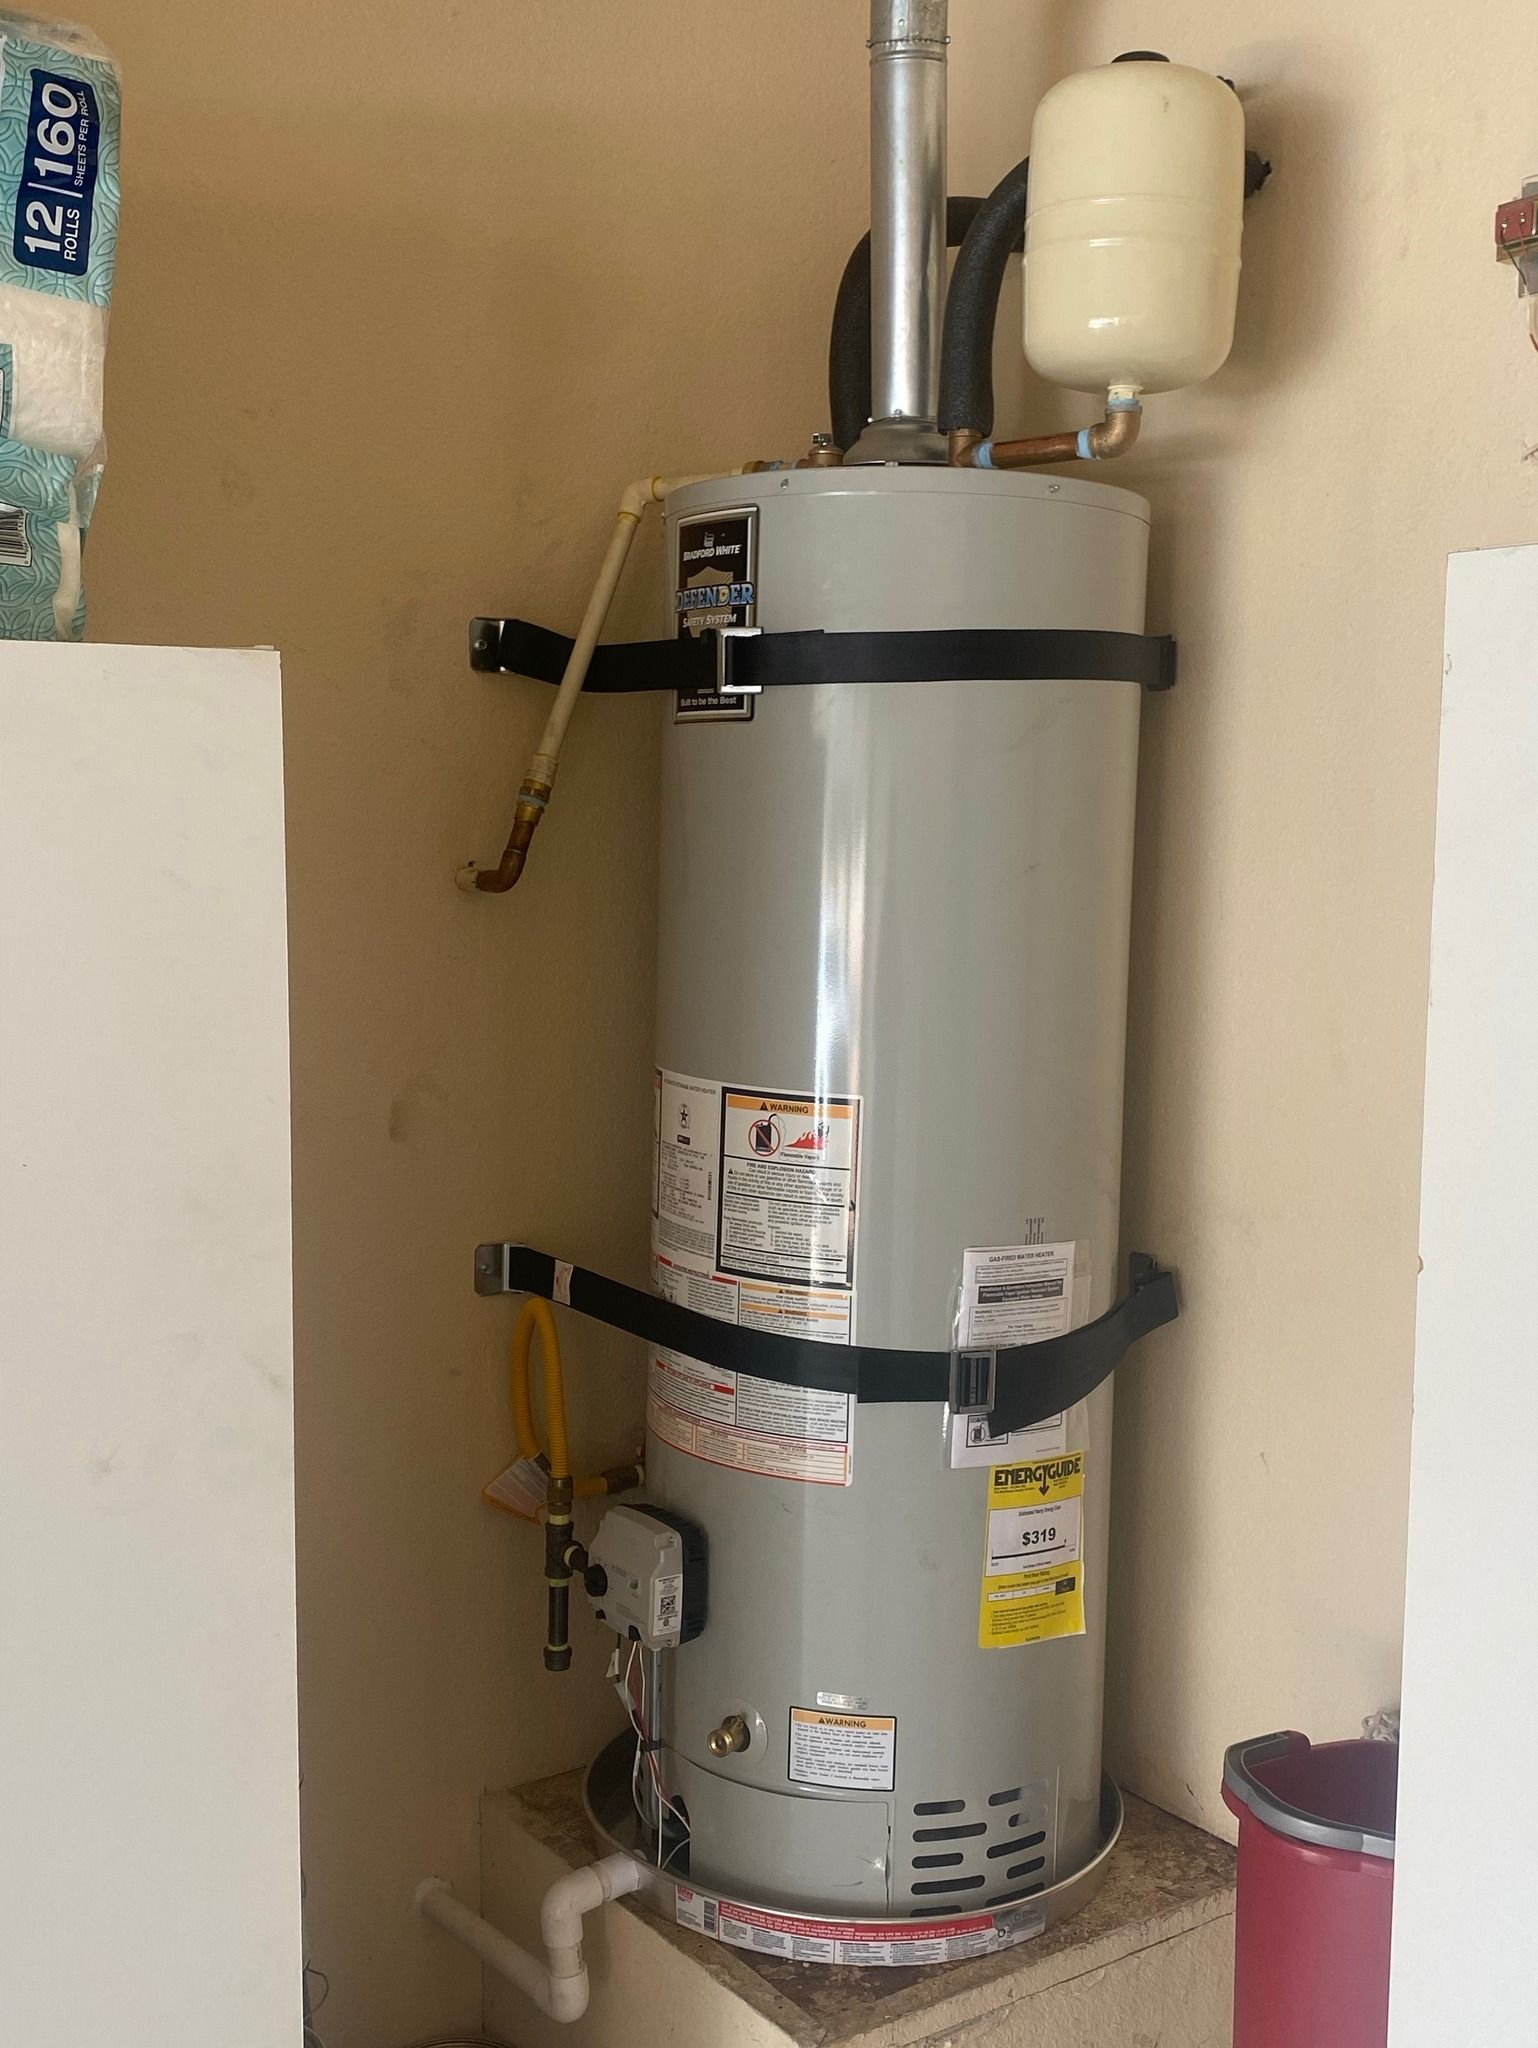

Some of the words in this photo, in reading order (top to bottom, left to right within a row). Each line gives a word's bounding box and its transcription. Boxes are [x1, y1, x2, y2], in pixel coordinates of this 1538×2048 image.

[77, 90, 89, 116] ROLL
[34, 82, 78, 176] 160
[78, 117, 89, 140] PER
[74, 143, 87, 187] SHEETS
[24, 200, 64, 253] 12
[64, 207, 80, 261] ROLLS
[683, 547, 715, 561] BRADFORD
[715, 545, 741, 556] WHITE
[675, 583, 754, 612] DEFENDER
[707, 697, 718, 705] the
[720, 696, 736, 704] Best
[770, 1103, 809, 1114] WARNING
[1022, 1527, 1056, 1546] $319
[825, 1717, 867, 1728] WARNING
